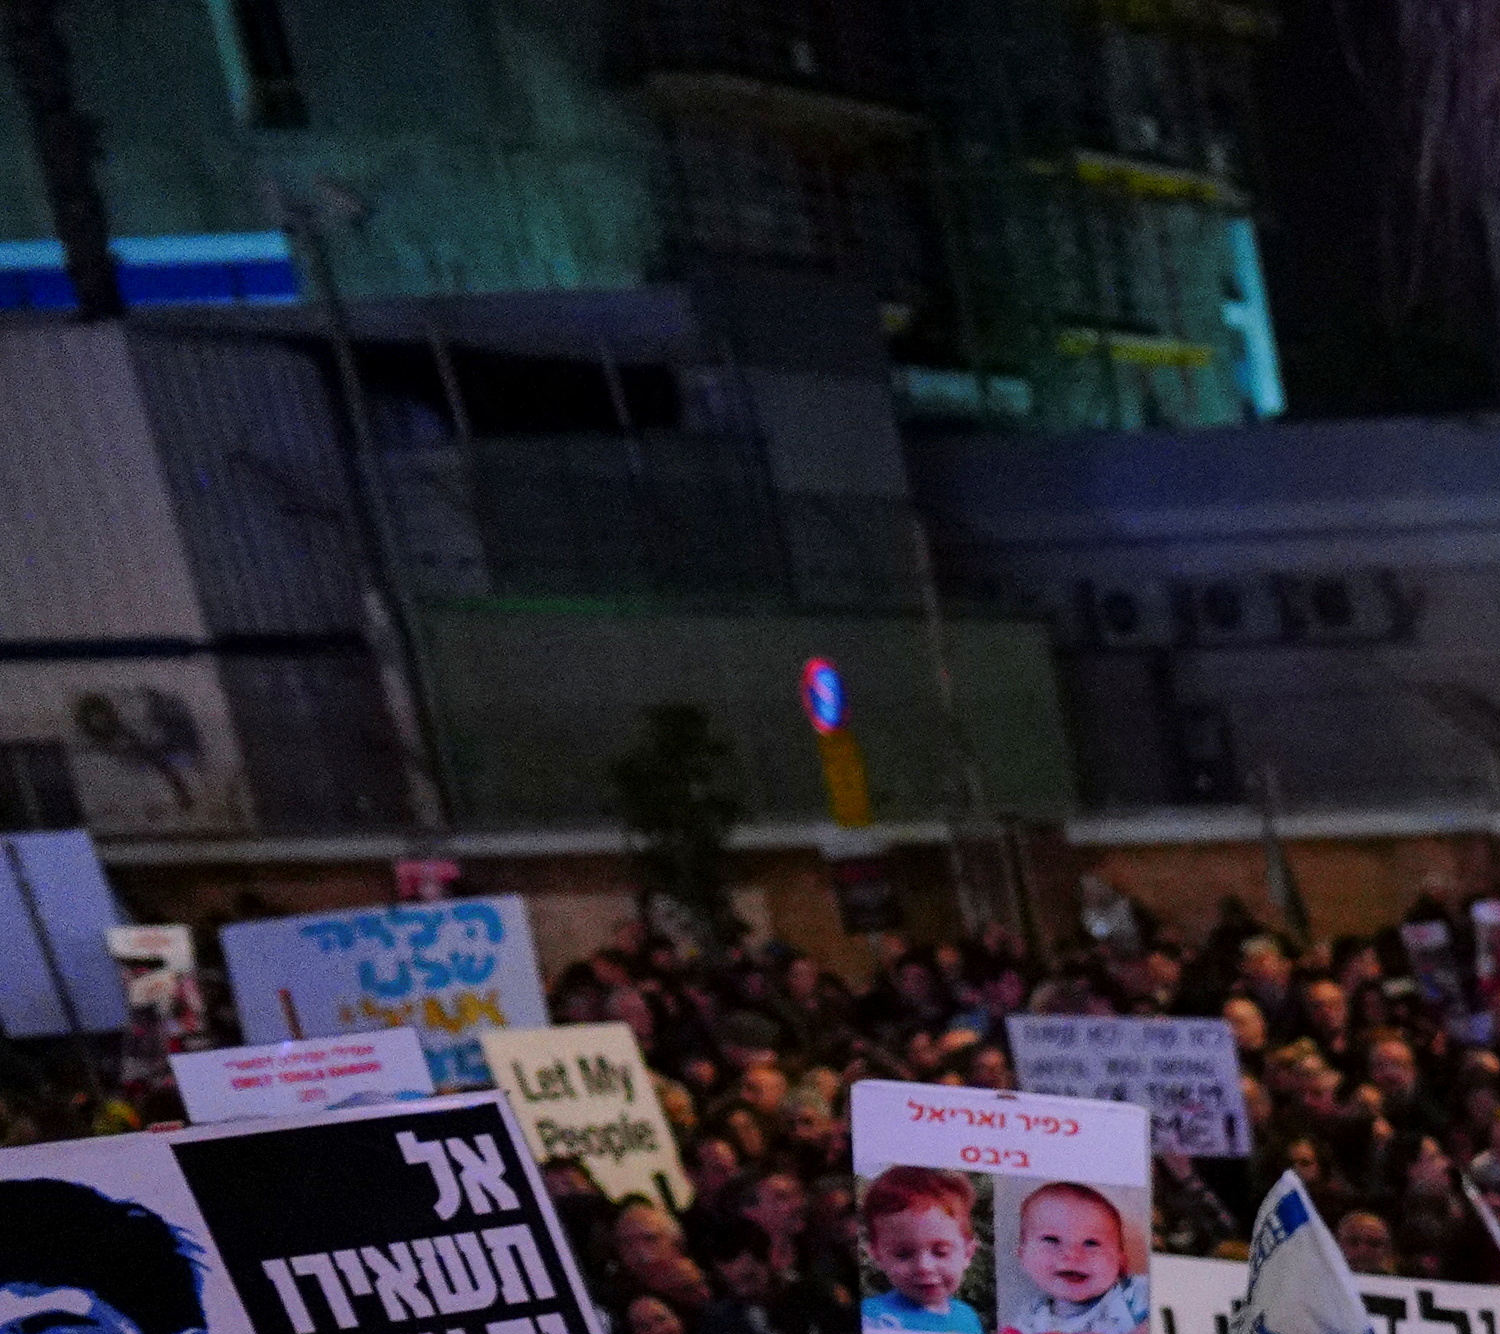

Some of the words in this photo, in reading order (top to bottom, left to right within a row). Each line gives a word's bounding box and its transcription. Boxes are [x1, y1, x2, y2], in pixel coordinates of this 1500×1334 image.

[512, 1063, 575, 1104] Let
[580, 1055, 635, 1103] My
[907, 1100, 1006, 1128] ואריאל
[1016, 1114, 1080, 1136] כפיר
[538, 1121, 656, 1157] People
[960, 1146, 1030, 1168] ביבס
[396, 1132, 519, 1219] אל
[262, 1224, 555, 1334] תשאירו
